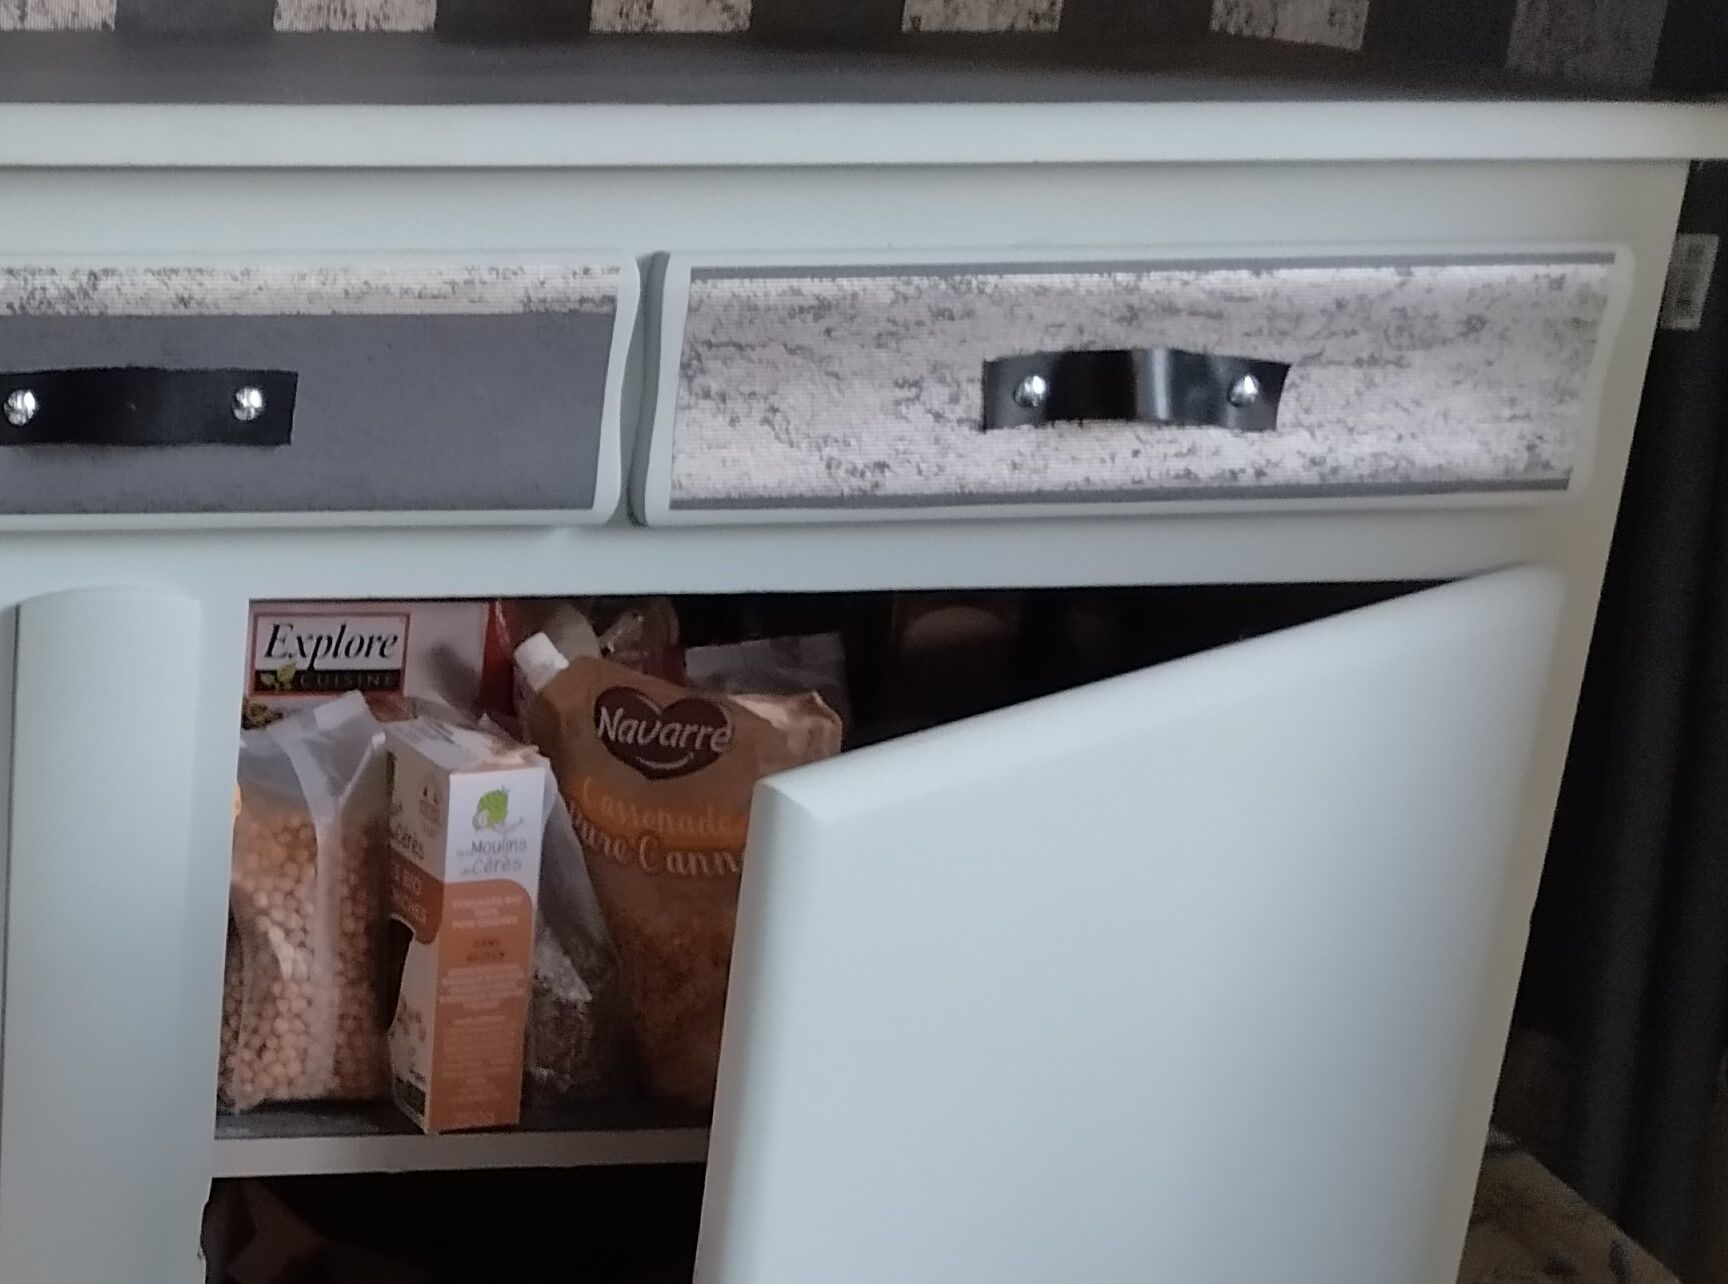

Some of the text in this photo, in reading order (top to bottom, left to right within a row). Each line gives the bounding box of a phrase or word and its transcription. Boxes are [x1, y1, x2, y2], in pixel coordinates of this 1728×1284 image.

[264, 620, 398, 672] Explore
[300, 672, 391, 688] CUISINE
[597, 704, 731, 753] Navarre
[472, 838, 528, 855] Moulins
[639, 833, 740, 876] Cann
